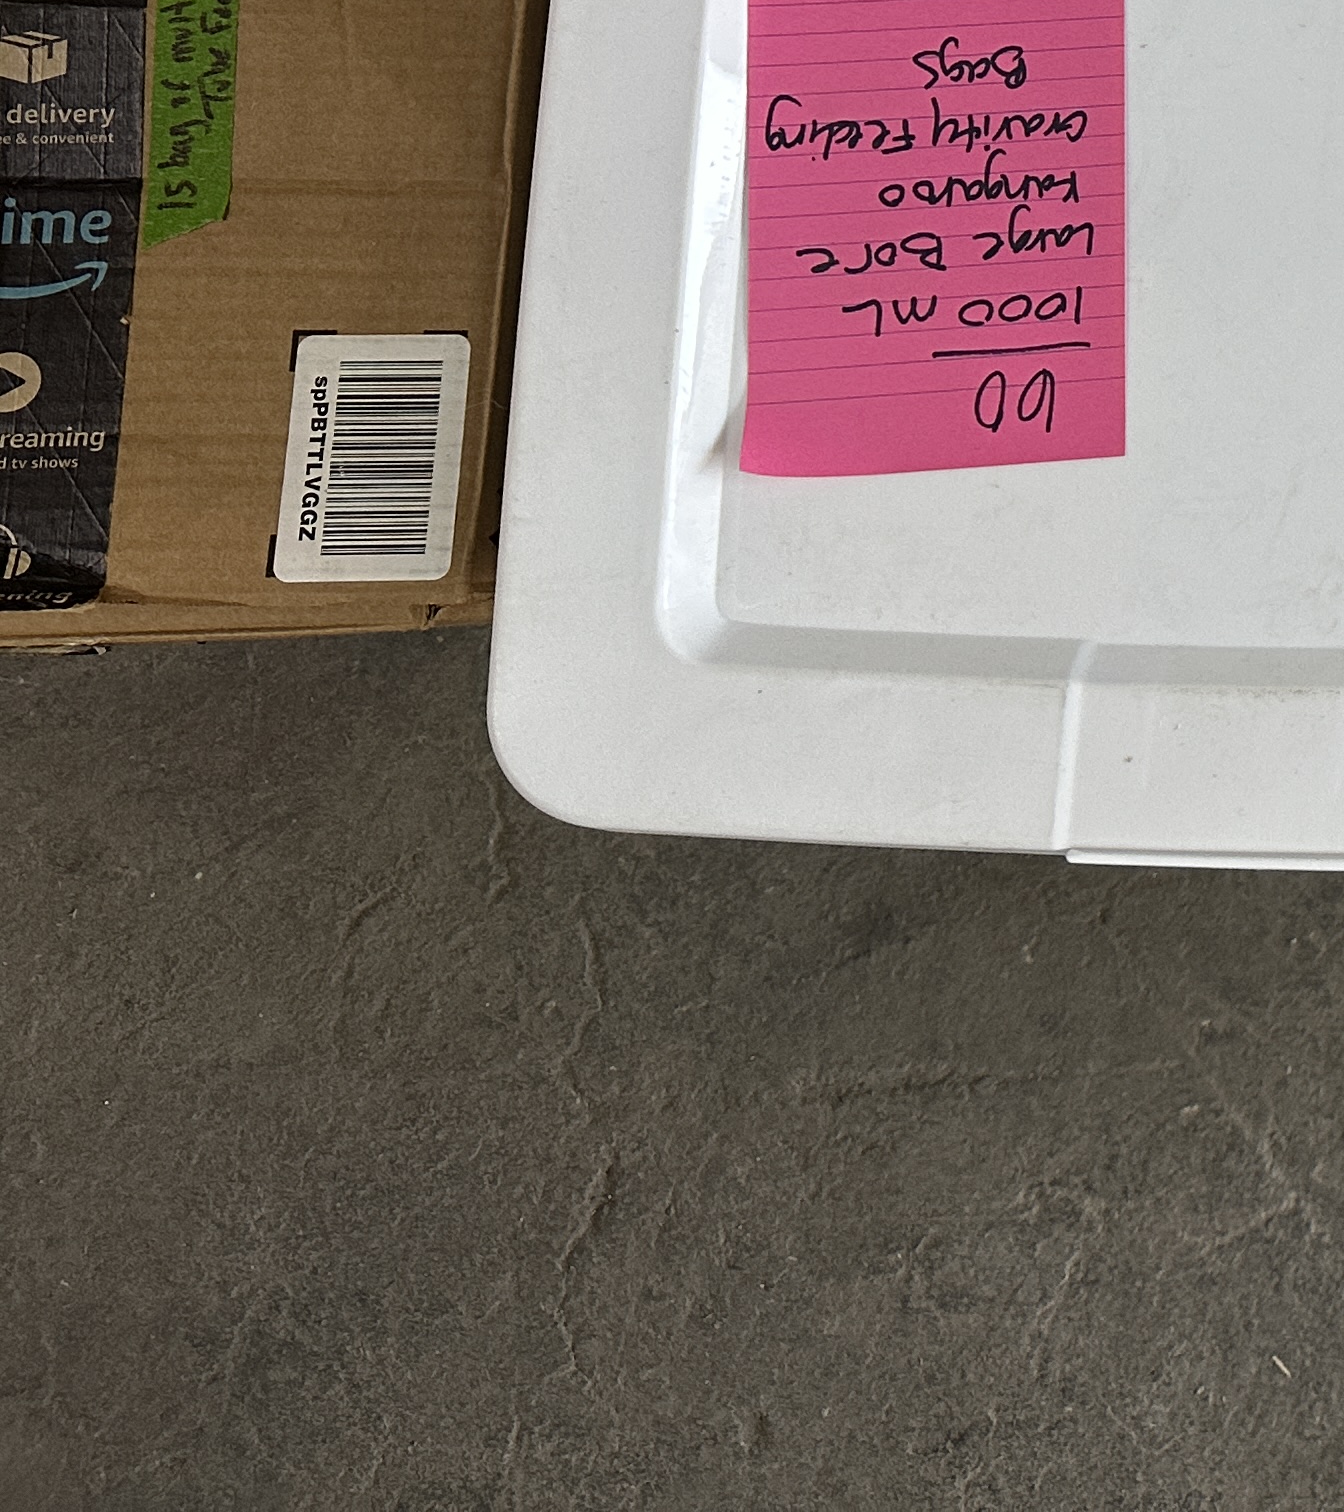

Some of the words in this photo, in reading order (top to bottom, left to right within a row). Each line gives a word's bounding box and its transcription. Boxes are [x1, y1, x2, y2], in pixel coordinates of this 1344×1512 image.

[911, 33, 1026, 94] Bags
[6, 103, 115, 127] delivery
[15, 132, 26, 144] &
[32, 131, 114, 143] convenient
[763, 88, 914, 162] Feeding
[929, 89, 1088, 153] Gravity
[875, 145, 1078, 212] Kangaroo
[794, 231, 946, 277] Bore
[970, 201, 1095, 260] Large
[841, 295, 938, 338] mL
[957, 286, 1083, 331] 1000
[11, 458, 27, 468] tv
[31, 455, 78, 468] shows
[298, 376, 329, 541] spPBTTLVGGZ
